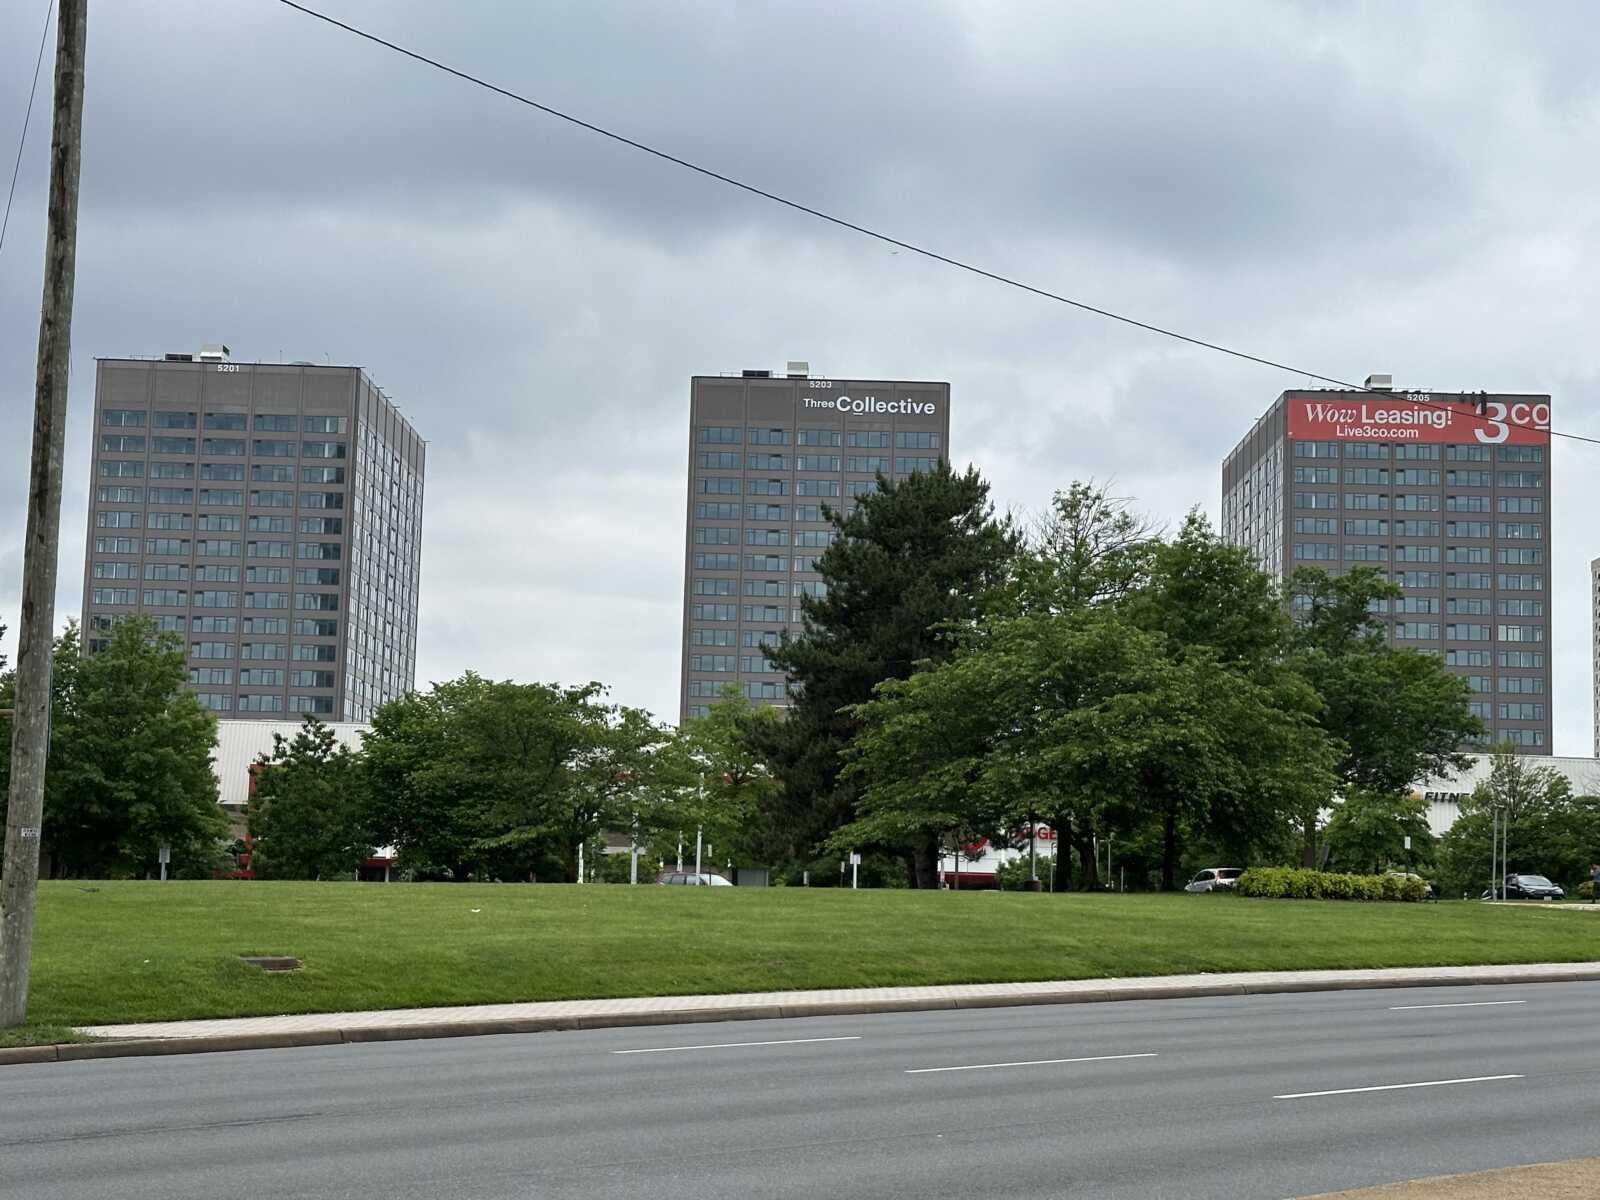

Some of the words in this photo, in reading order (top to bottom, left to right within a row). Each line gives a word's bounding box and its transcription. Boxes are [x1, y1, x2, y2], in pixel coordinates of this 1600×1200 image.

[217, 364, 240, 372] 5201
[809, 381, 832, 389] 5203
[1407, 394, 1430, 402] 5205
[803, 398, 835, 408] Three
[836, 396, 936, 415] Collective
[1304, 403, 1357, 423] Wow
[1361, 405, 1453, 429] Leasing!
[1336, 425, 1419, 438] Live3co.com
